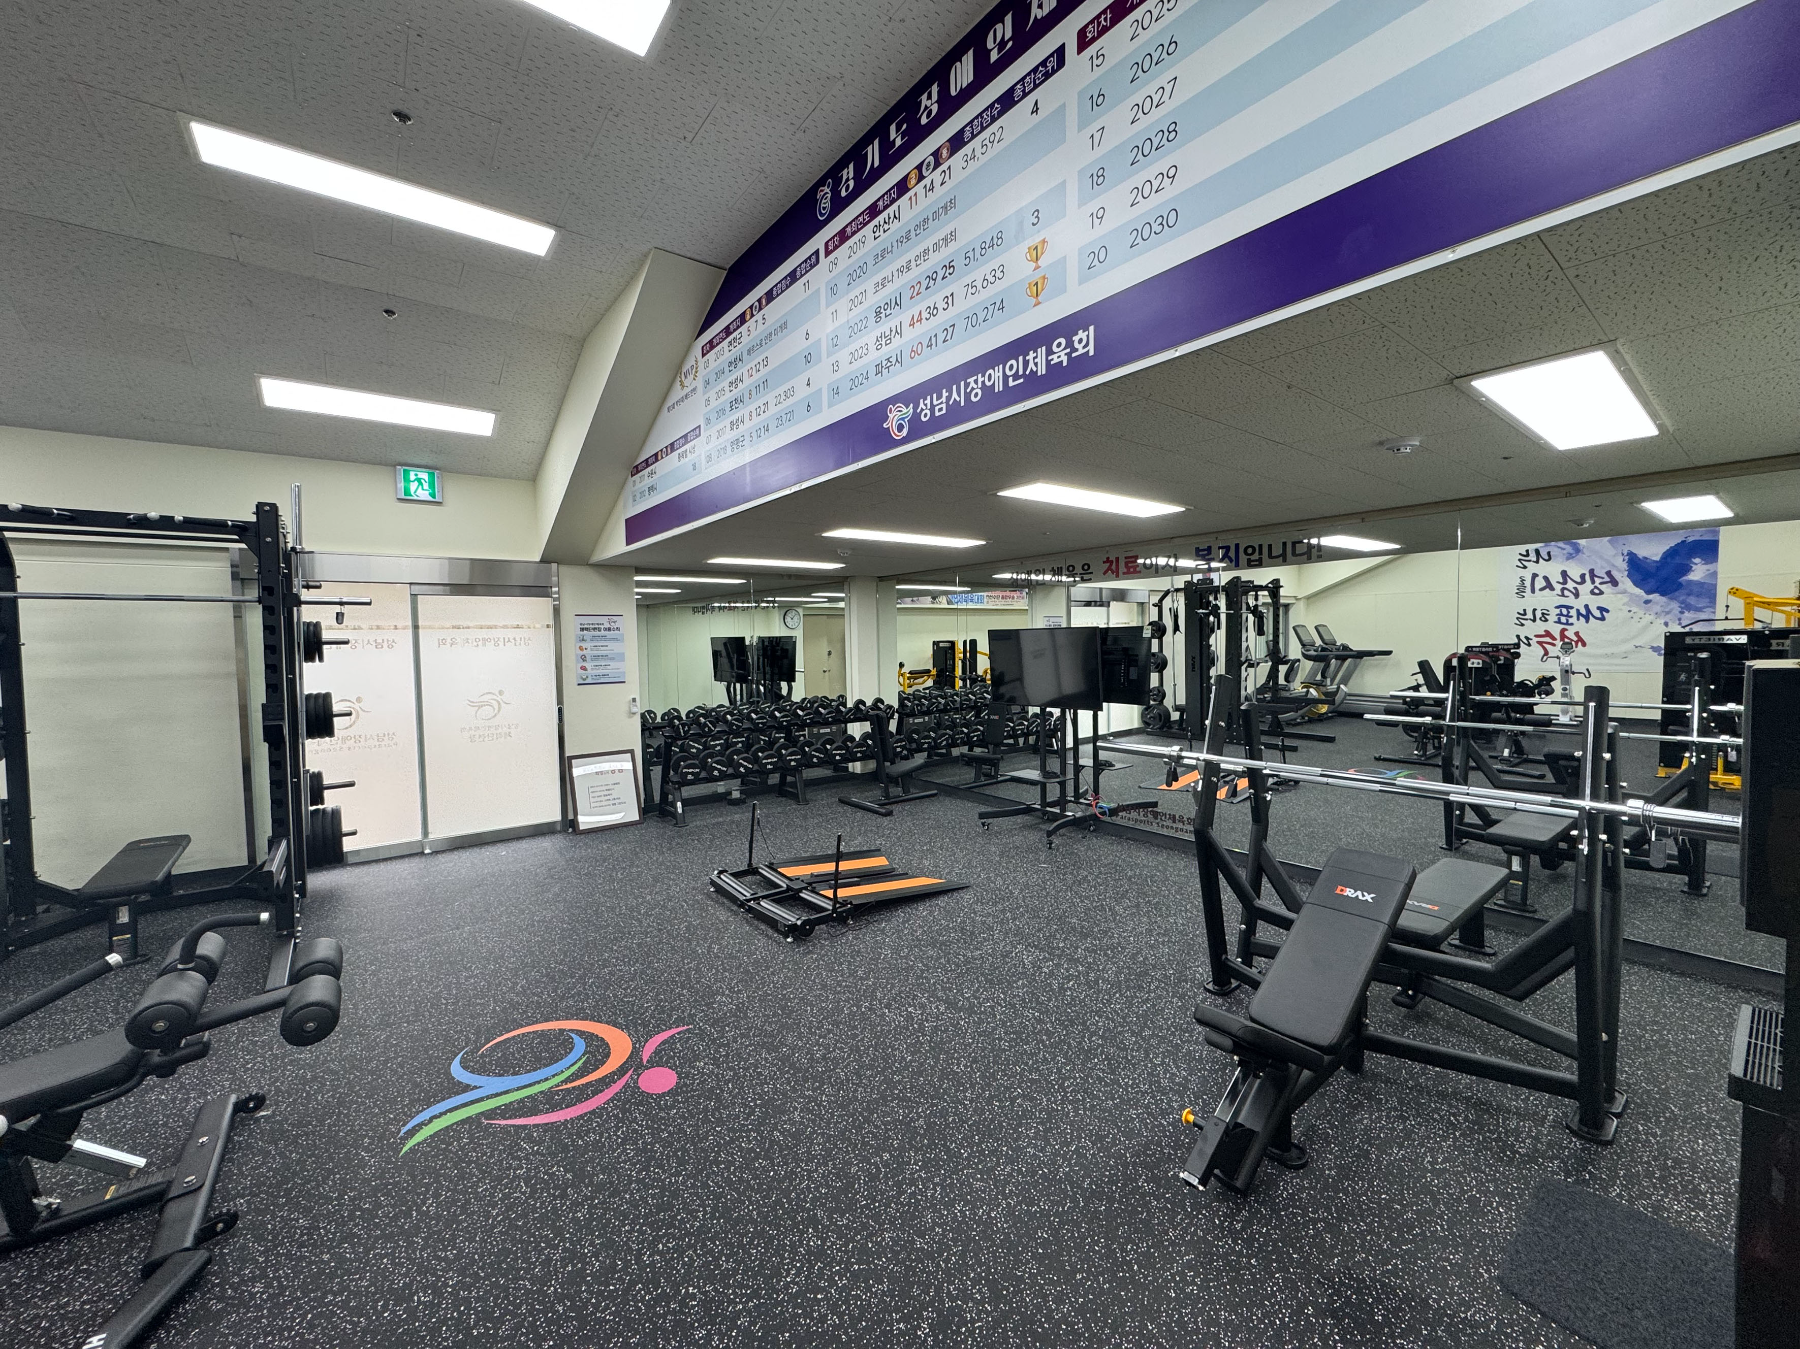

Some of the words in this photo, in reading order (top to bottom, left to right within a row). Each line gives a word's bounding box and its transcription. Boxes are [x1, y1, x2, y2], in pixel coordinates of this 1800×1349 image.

[1085, 8, 1112, 42] 회차
[1088, 46, 1106, 73] 15
[1129, 0, 1178, 42] 2025
[1088, 87, 1106, 112] 16
[1129, 33, 1178, 84] 2026
[1089, 126, 1105, 151] 17
[1130, 75, 1178, 126] 2027
[827, 235, 840, 252] 회차
[844, 210, 870, 237] 개최연도
[876, 186, 897, 212] 개최지
[963, 101, 1001, 143] 종합점수
[1013, 53, 1057, 101] 종합순위
[1088, 166, 1106, 190] 18
[1129, 121, 1178, 167] 2028
[828, 257, 839, 274] 09
[847, 234, 867, 260] 2019
[872, 204, 901, 241] 안산시
[907, 191, 918, 210] 11
[922, 178, 935, 199] 14
[940, 164, 952, 187] 21
[961, 125, 1004, 170] 34,592
[1030, 98, 1040, 117] 4
[1089, 206, 1106, 230] 19
[1129, 164, 1178, 208] 2029
[795, 254, 817, 278] 종합순위
[829, 283, 839, 298] 10
[846, 261, 868, 287] 2020
[872, 242, 894, 267] 코로나
[895, 229, 912, 250] 19로
[914, 215, 930, 237] 인한
[932, 195, 957, 222] 미개최
[1087, 245, 1108, 271] 20
[1129, 208, 1179, 249] 2030
[747, 325, 752, 337] 5
[754, 319, 759, 331] 7
[761, 313, 767, 325] 5
[803, 279, 810, 293] 11
[831, 310, 838, 323] 11
[848, 289, 867, 313] 2021
[873, 270, 894, 295] 코로나
[895, 260, 913, 280] 19로
[914, 246, 930, 268] 인한
[932, 227, 957, 254] 미개최
[831, 334, 839, 349] 12
[848, 316, 869, 339] 2022
[873, 291, 903, 324] 용인시
[909, 280, 922, 301] 22
[924, 270, 938, 292] 29
[940, 259, 956, 281] 25
[963, 230, 1004, 267] 51,848
[1031, 208, 1041, 227] 3
[831, 360, 840, 374] 13
[848, 342, 870, 365] 2023
[874, 320, 903, 351] 성남시
[908, 309, 924, 329] 44
[924, 302, 939, 322] 36
[942, 292, 955, 312] 31
[963, 263, 1006, 300] 75,633
[1032, 244, 1039, 262] 1
[831, 384, 840, 400] 14
[848, 370, 870, 391] 2024
[874, 349, 903, 378] 파주시
[909, 341, 924, 360] 60
[926, 333, 938, 351] 41
[942, 323, 956, 344] 27
[963, 298, 1006, 332] 70,274
[1032, 281, 1039, 298] 1
[683, 364, 695, 381] MVP
[727, 351, 743, 373] 안성시
[764, 331, 773, 346] 인한
[773, 319, 788, 337] 미개최
[728, 372, 744, 393] 안성시
[747, 366, 753, 379] 12
[754, 361, 761, 374] 12
[762, 356, 769, 369] 13
[804, 329, 810, 341] 6
[755, 384, 761, 396] 11
[762, 379, 769, 391] 11
[803, 352, 812, 365] 10
[916, 324, 1096, 422] 성남시장애인체육회
[729, 413, 745, 432] 화성시
[748, 411, 753, 421] 8
[755, 406, 761, 417] 12
[762, 400, 769, 414] 21
[774, 385, 795, 407] 22,303
[805, 377, 811, 388] 4
[730, 434, 746, 453] 양평군
[755, 427, 762, 439] 12
[763, 423, 770, 435] 14
[775, 409, 795, 429] 23,721
[806, 401, 812, 413] 6
[1050, 562, 1094, 583] 체육은
[1102, 553, 1178, 579] 치료이자
[1194, 538, 1323, 572] 복지입니다!
[1335, 885, 1377, 903] DRAX
